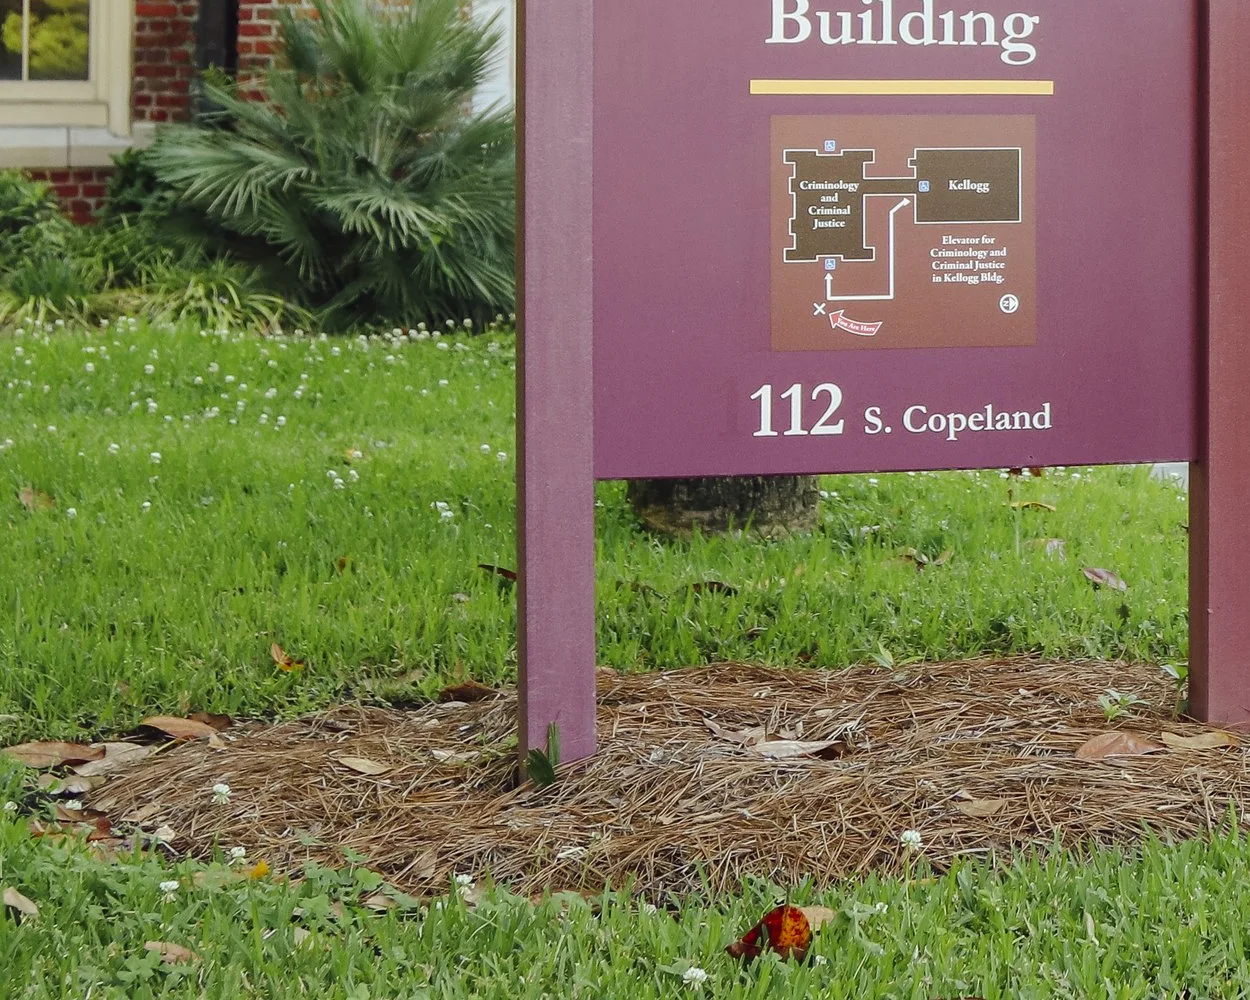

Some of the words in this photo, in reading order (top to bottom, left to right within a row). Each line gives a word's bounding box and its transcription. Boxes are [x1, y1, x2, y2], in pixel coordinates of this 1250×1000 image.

[800, 180, 859, 192] Criminology
[949, 180, 989, 193] Kellogg
[821, 193, 838, 202] and
[809, 206, 850, 214] Criminal
[813, 219, 845, 229] Justice
[943, 236, 980, 244] Elevator
[982, 235, 995, 244] for
[930, 248, 988, 259] Criminology
[990, 247, 1006, 256] and
[932, 260, 973, 269] Criminal
[974, 261, 1005, 271] Justice
[933, 274, 942, 282] in
[944, 273, 979, 284] Kellogg
[981, 272, 1004, 284] Bldg.
[751, 384, 844, 436] 112
[865, 407, 891, 433] S.
[904, 403, 1051, 440] Copeland
